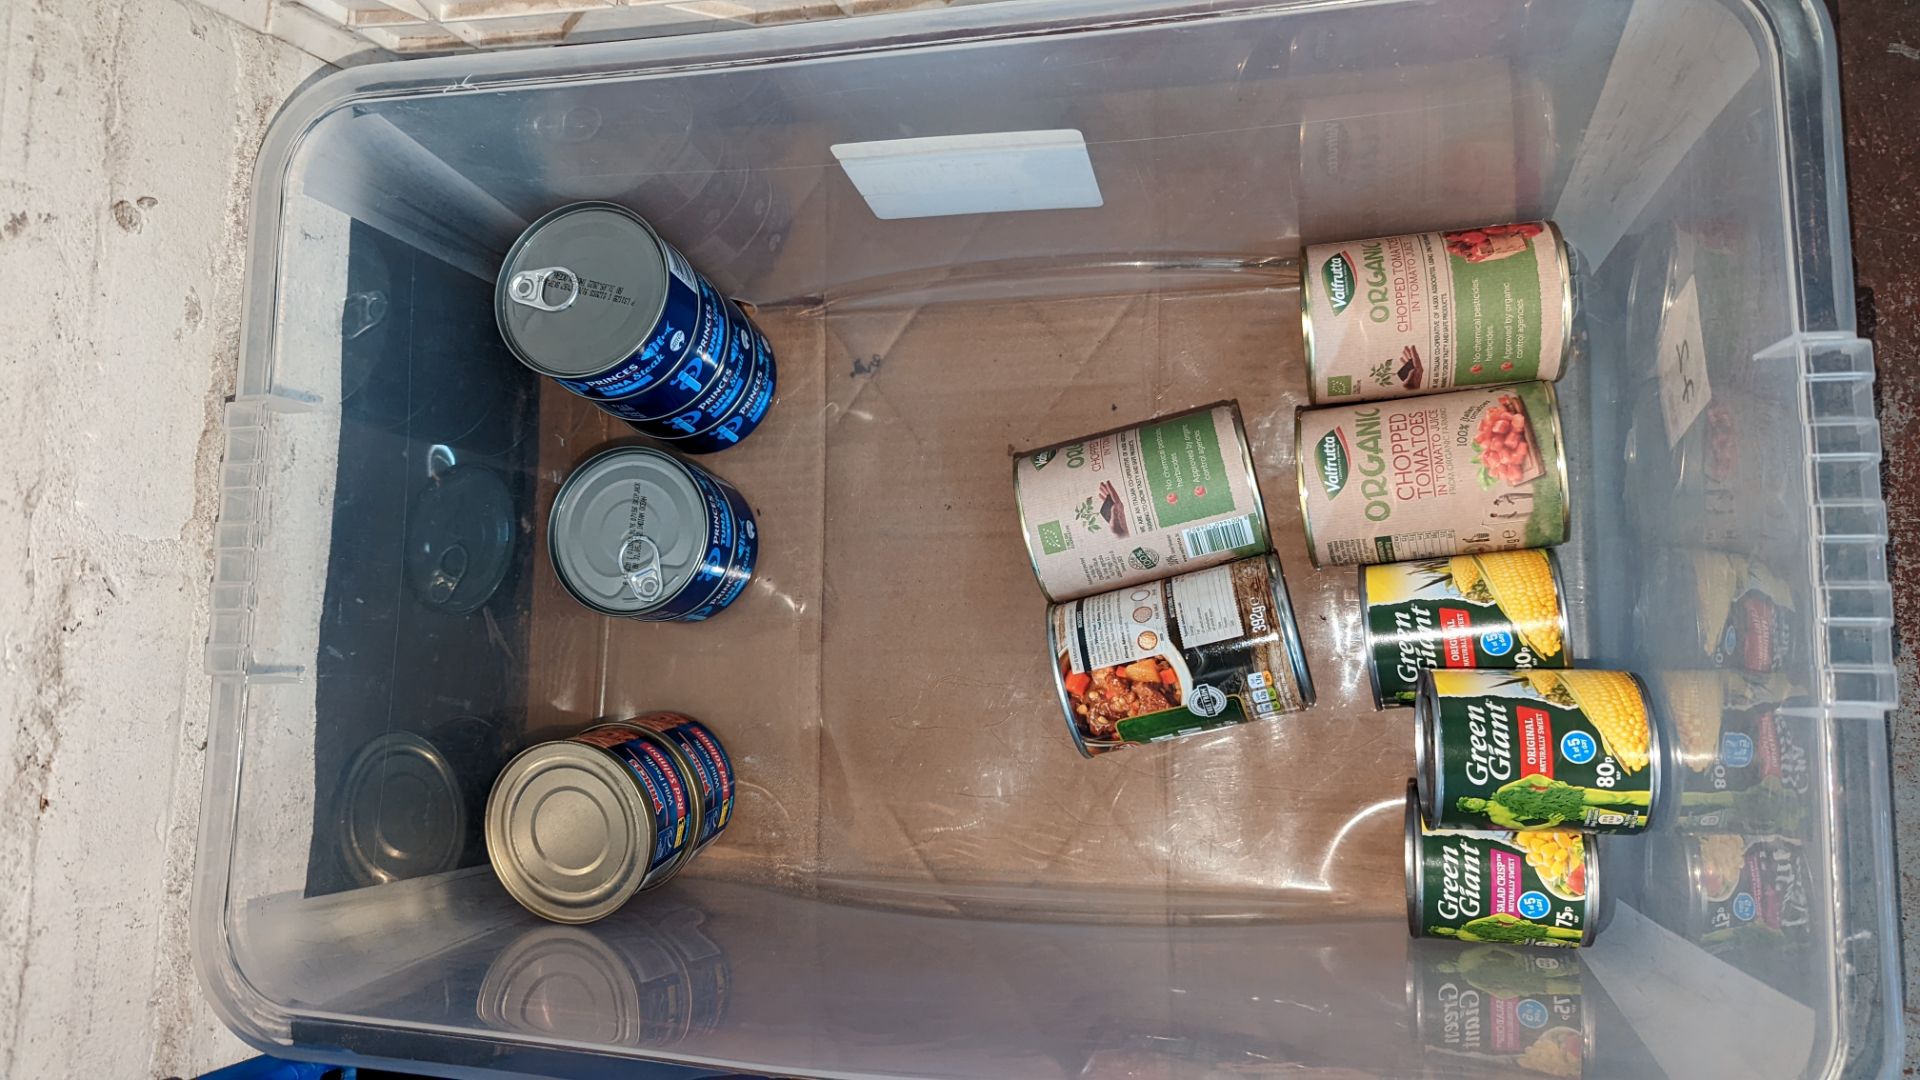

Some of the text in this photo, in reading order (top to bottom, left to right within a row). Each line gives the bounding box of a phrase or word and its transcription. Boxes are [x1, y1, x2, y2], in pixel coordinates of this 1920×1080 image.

[1330, 257, 1347, 308] Valfrutta
[1361, 242, 1389, 323] ORGANIC
[1409, 258, 1420, 301] TOMATO
[1393, 278, 1408, 332] CHOPPED
[1412, 304, 1420, 312] IN
[1504, 282, 1514, 359] Approved by organic
[697, 303, 711, 355] PRINCES
[706, 327, 718, 360] TUNA
[1472, 316, 1481, 352] chemical
[1516, 335, 1525, 358] control
[585, 364, 638, 387] PRINCES
[596, 354, 665, 391] TUNA Steak
[1473, 353, 1480, 363] No
[698, 368, 732, 410] PRINCES
[706, 354, 744, 414] TUNA Steak
[739, 371, 762, 415] PRINCES
[746, 390, 765, 419] TUNA
[1409, 411, 1432, 499] TOMATOES
[1428, 408, 1448, 495] IN TOMATO JUICE
[1457, 424, 1470, 447] 100%
[1187, 450, 1200, 483] Approved
[1199, 455, 1211, 480] control
[1324, 436, 1341, 492] Valfrutta
[1355, 407, 1391, 521] ORGANIC
[1389, 413, 1415, 500] CHOPPED
[1443, 442, 1453, 473] ORGANIC
[1165, 479, 1172, 490] No
[1447, 474, 1456, 495] FROM
[708, 495, 719, 544] PRINCES
[1136, 549, 1155, 568] 100%
[710, 565, 740, 605] PRINCS
[1250, 606, 1267, 633] 392g
[1411, 606, 1437, 669] Giant
[1395, 612, 1419, 683] Green
[1447, 619, 1459, 661] ORIGAL
[1461, 634, 1470, 667] NATURALL
[697, 731, 723, 768] Salmon
[1466, 705, 1488, 786] Green
[1485, 702, 1511, 781] Giant
[1525, 718, 1536, 765] ORIGINAL
[1536, 713, 1547, 773] NATURALLY SWEET
[1568, 738, 1580, 746] 5
[1580, 739, 1589, 749] day
[643, 755, 673, 806] Wild Pacific
[648, 746, 676, 783] Salmon
[681, 743, 711, 796] PRINCES
[695, 739, 719, 789] Wild Pacific
[720, 771, 729, 792] Red
[1596, 757, 1615, 788] 80p
[628, 759, 663, 815] PRINCES
[674, 788, 684, 810] Red
[1438, 846, 1459, 919] Green
[1459, 842, 1480, 917] Giant
[1497, 886, 1506, 912] SALAD
[1524, 897, 1536, 905] 5
[1536, 898, 1544, 906] day
[1555, 906, 1574, 927] 75p
